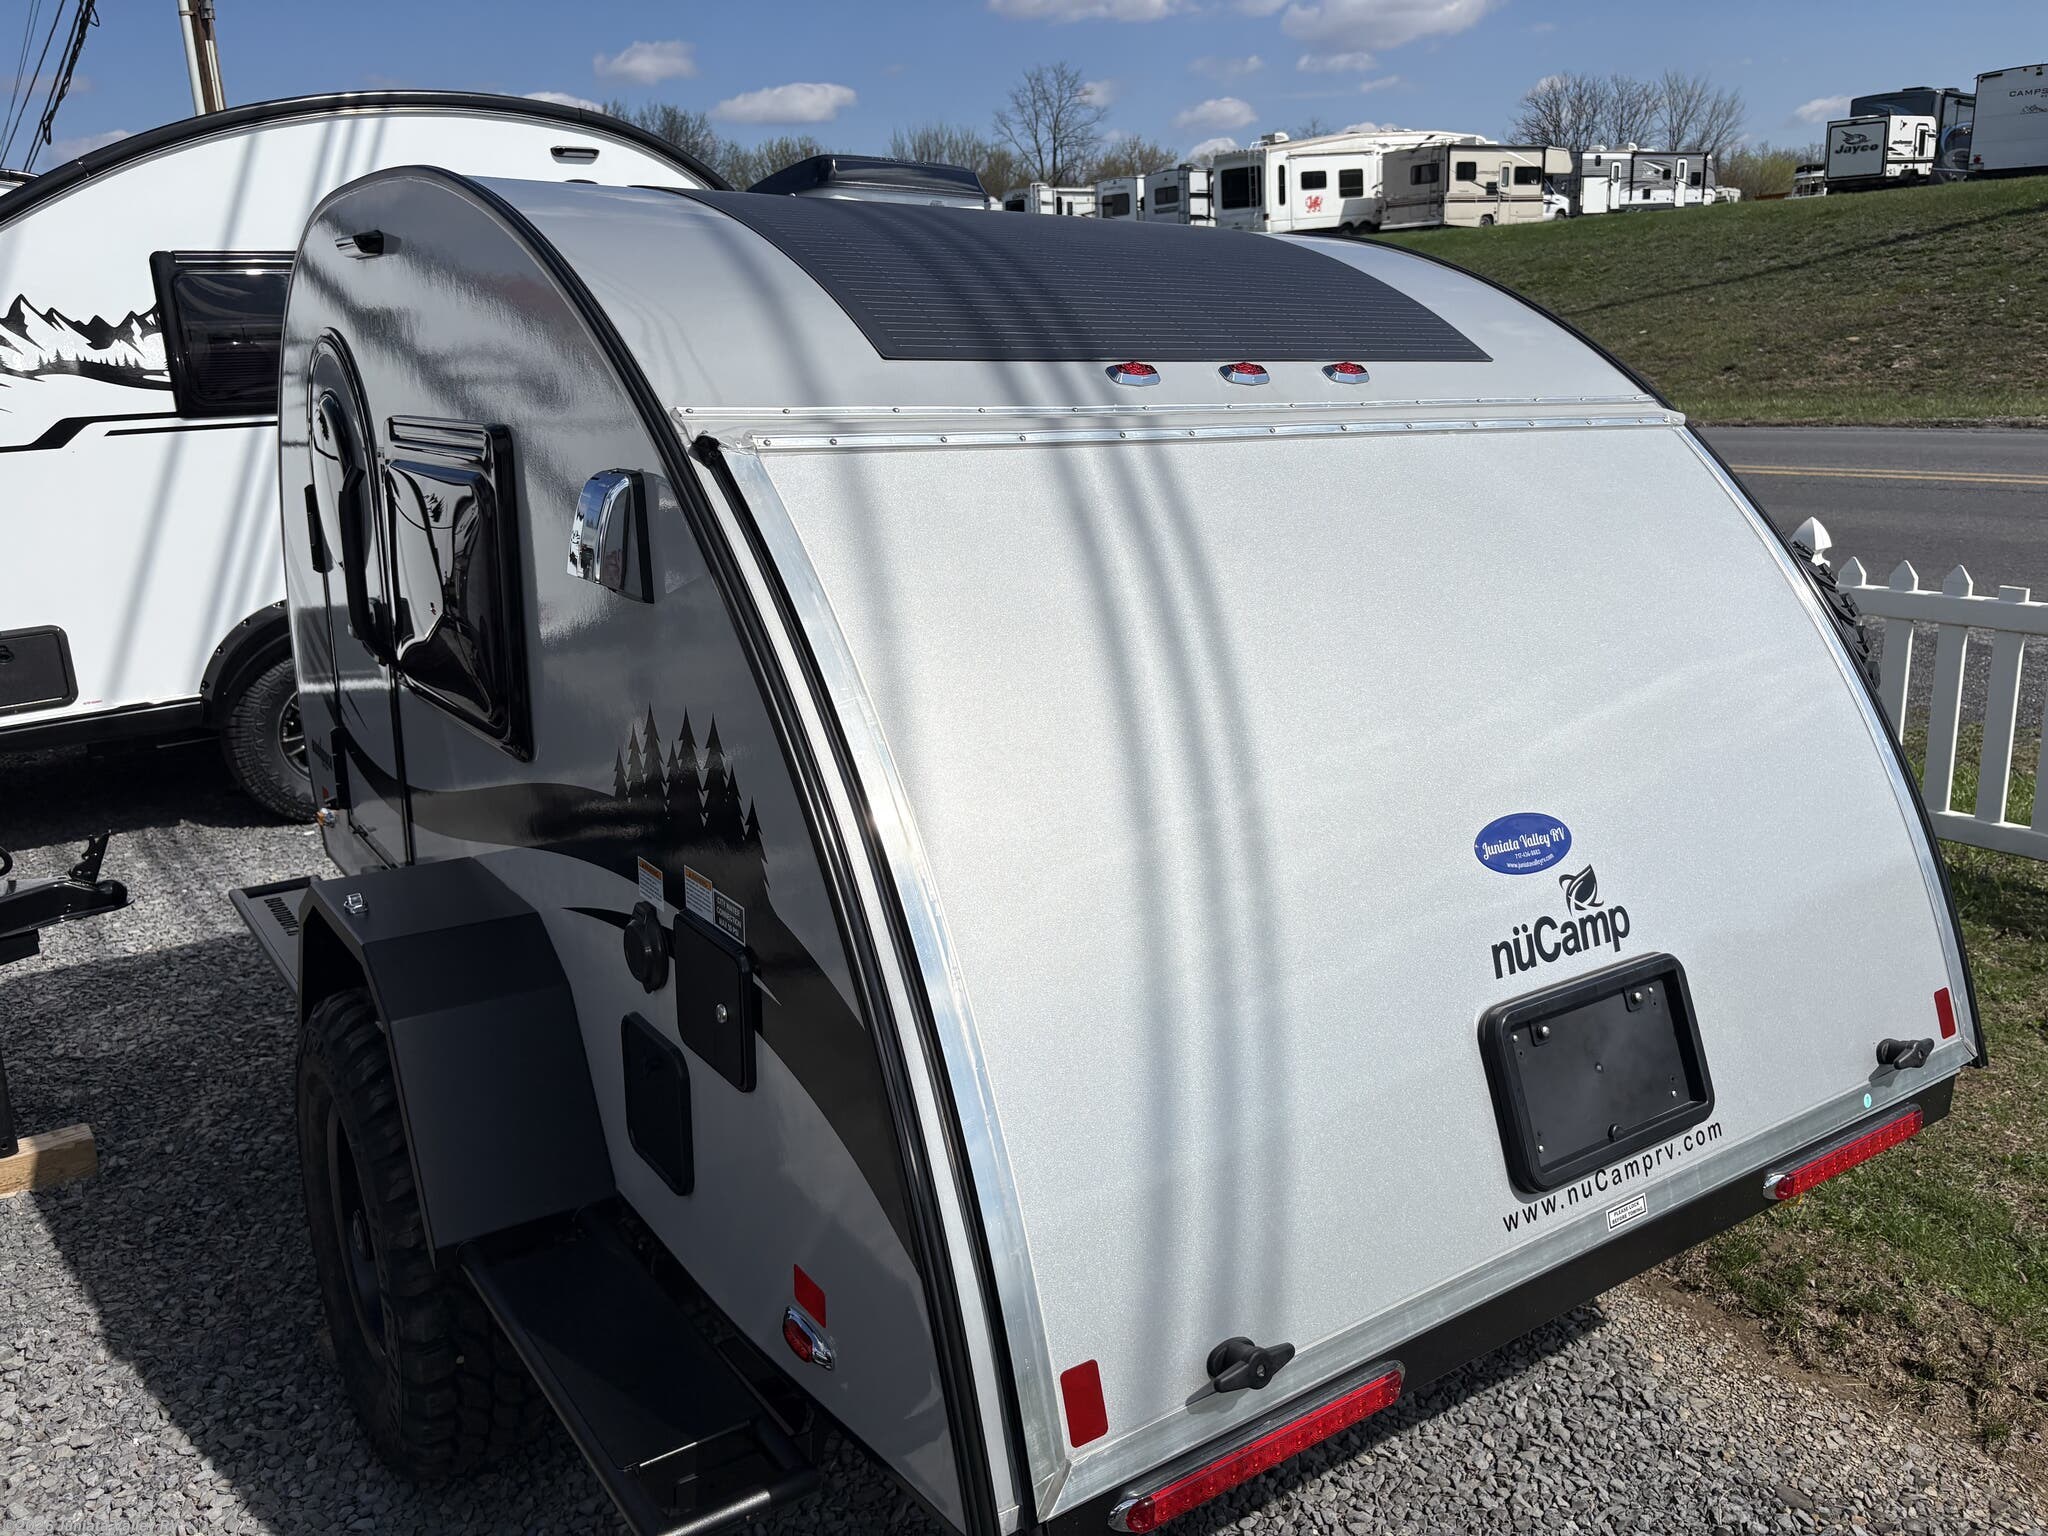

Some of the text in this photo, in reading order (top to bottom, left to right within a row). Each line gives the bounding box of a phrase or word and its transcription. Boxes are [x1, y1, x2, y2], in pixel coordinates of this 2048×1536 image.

[1835, 143, 1879, 154] Jayco
[1482, 827, 1565, 860] Juniata Valley RV
[1491, 905, 1630, 979] nüCamp
[1502, 1122, 1723, 1232] www.nuCamprv.com
